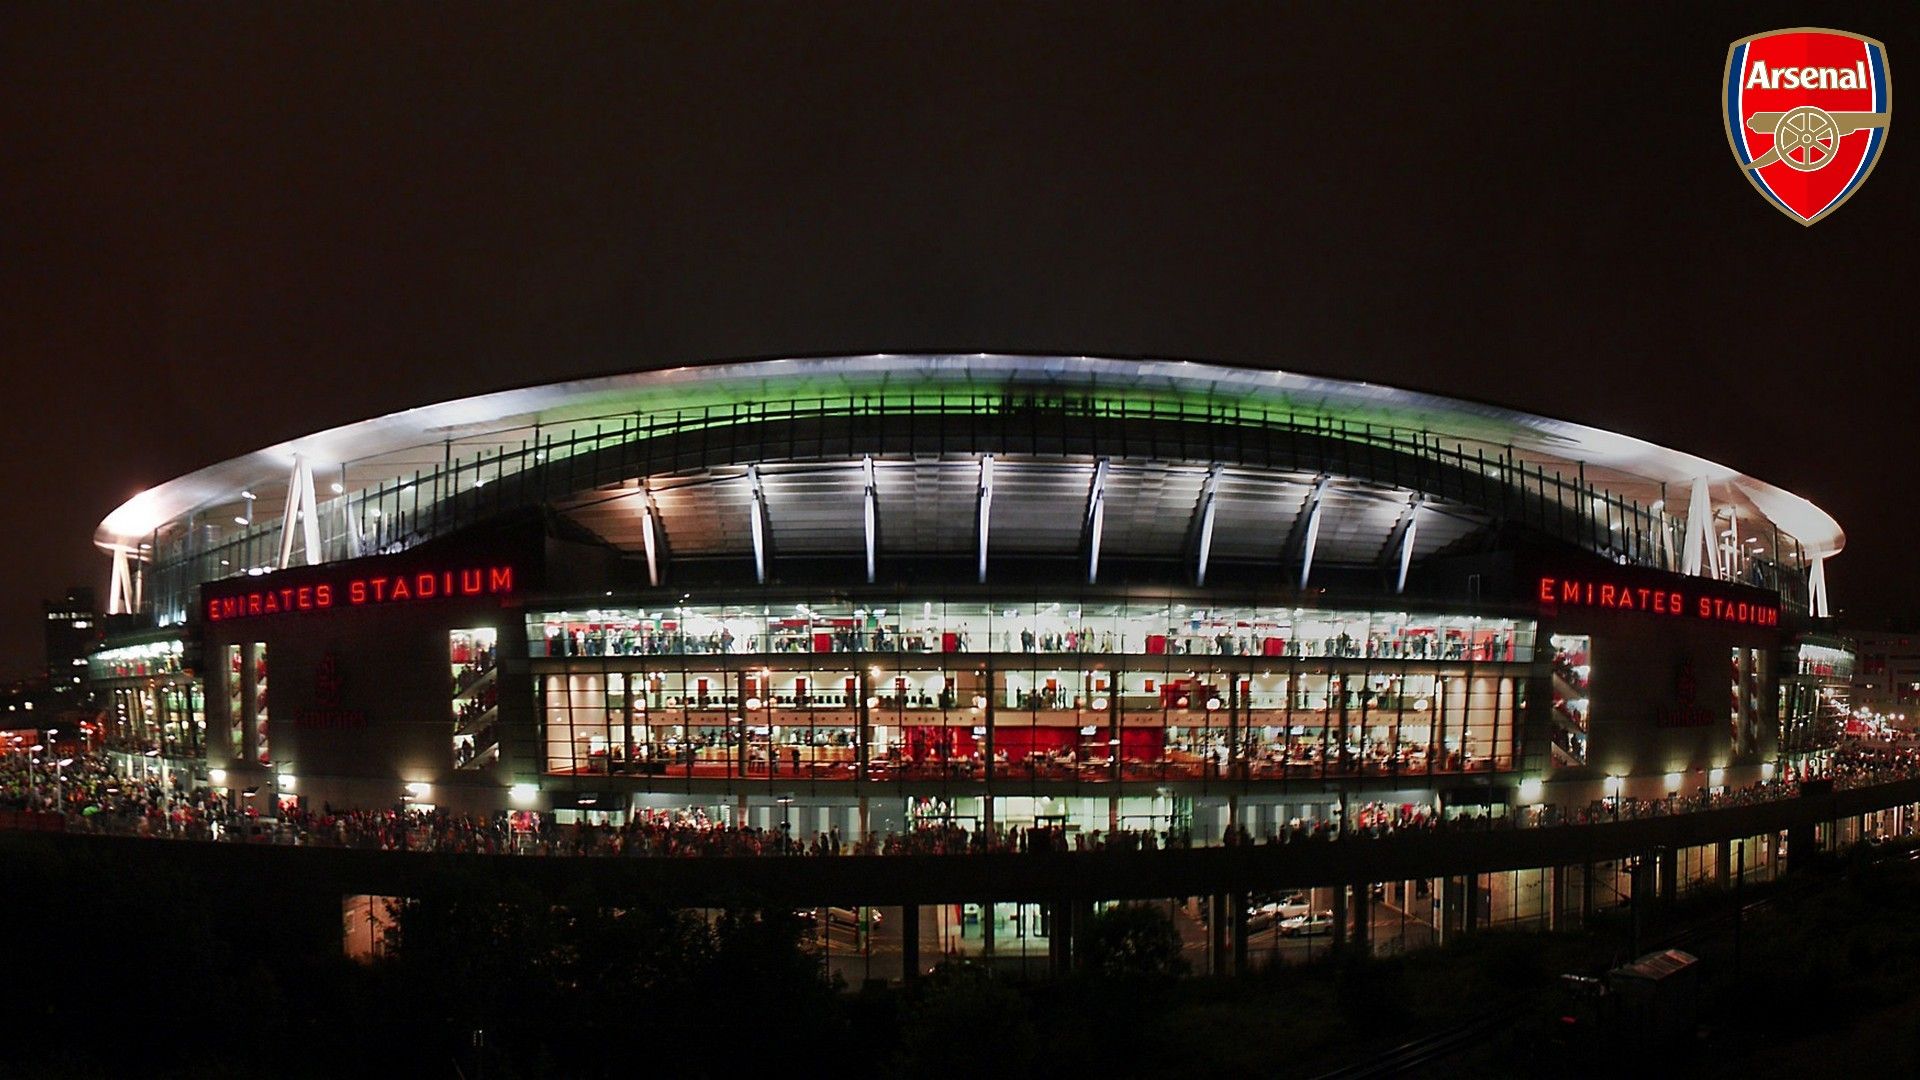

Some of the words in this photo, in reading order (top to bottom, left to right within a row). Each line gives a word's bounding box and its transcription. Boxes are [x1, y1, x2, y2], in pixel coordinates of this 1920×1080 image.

[209, 585, 331, 621] EMIRATES
[351, 567, 513, 603] STADIUM
[1540, 578, 1683, 613] EMIRATES
[1699, 597, 1778, 627] STADIUM
